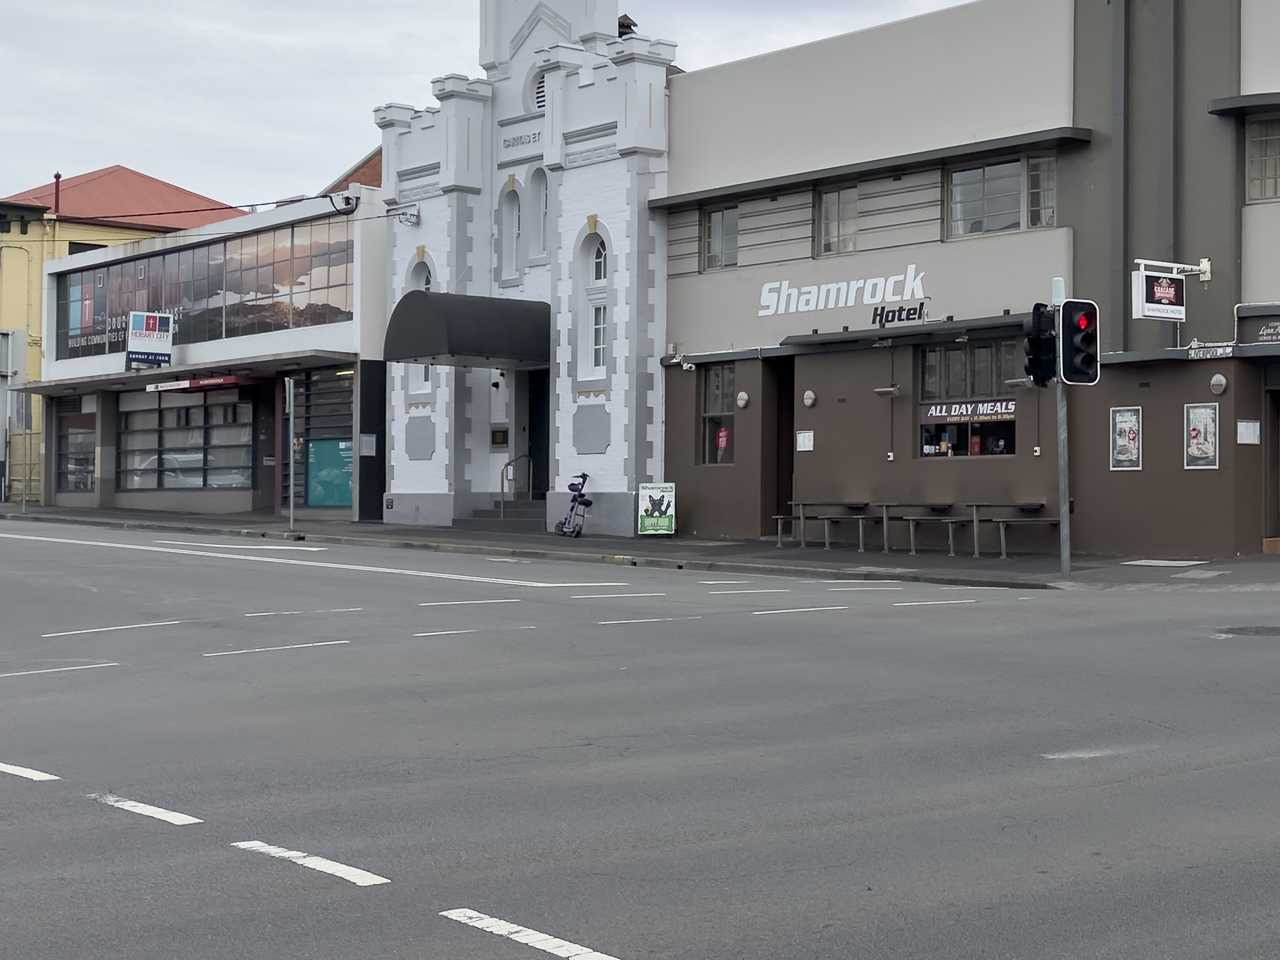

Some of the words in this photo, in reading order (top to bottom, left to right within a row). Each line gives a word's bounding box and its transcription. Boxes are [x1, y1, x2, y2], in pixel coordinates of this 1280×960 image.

[757, 263, 926, 317] Shamrock
[871, 302, 925, 325] Hotel
[927, 405, 949, 417] ALL
[950, 403, 975, 416] DAY
[976, 401, 1016, 415] MEALS
